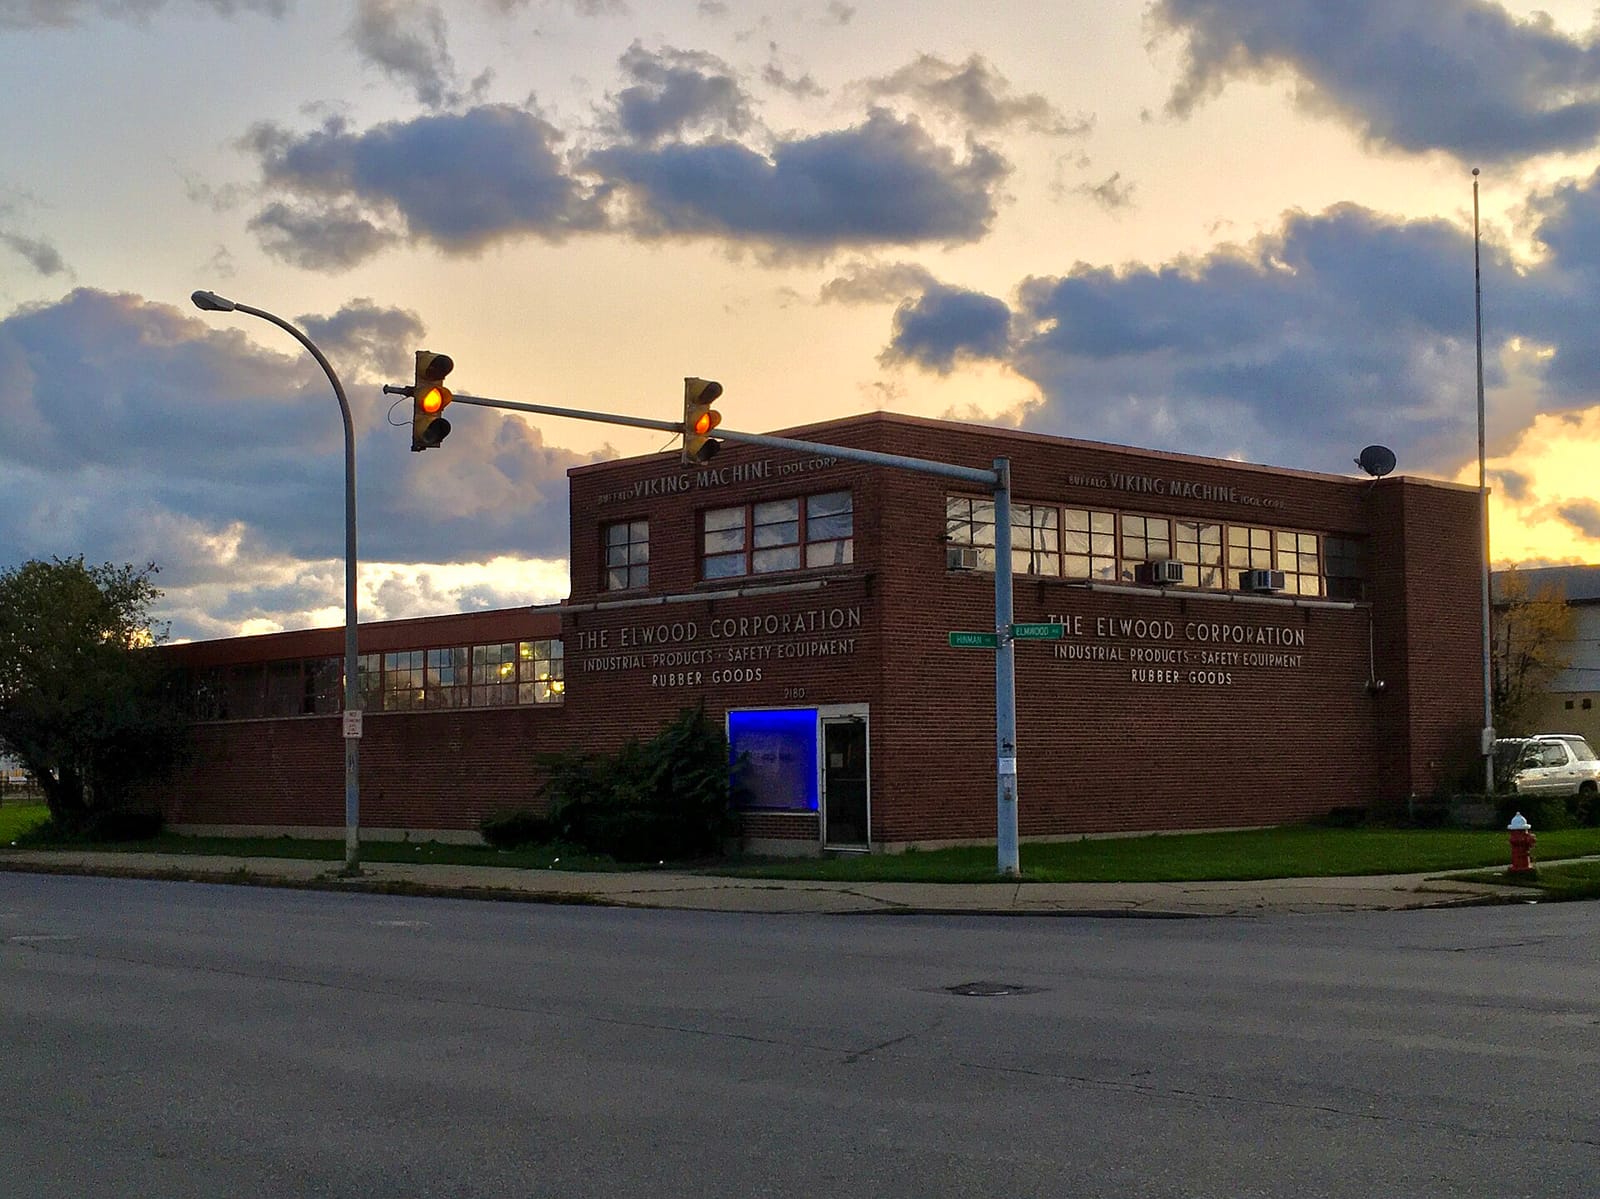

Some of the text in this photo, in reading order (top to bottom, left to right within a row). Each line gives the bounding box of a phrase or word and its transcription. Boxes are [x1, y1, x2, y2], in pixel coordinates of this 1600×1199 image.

[634, 474, 690, 498] VIKING
[696, 460, 772, 488] MACHINE
[777, 461, 803, 476] TOOL
[1110, 473, 1164, 495] VIKING
[1170, 481, 1237, 503] MACHINE
[578, 607, 862, 650] THE ELWOOD CORPORATION
[1016, 626, 1048, 636] ELMWOOD
[1097, 617, 1174, 640] ELWOOD
[1185, 622, 1305, 646] CORPORATION
[584, 639, 857, 672] INDUSTRIAL PRODUCTS SAFETY EQUIPMENT
[1055, 645, 1302, 667] INDUSTRIAL PRODUCTS SAFETY EQUIPMENT
[652, 668, 762, 687] RUBBER GOODS
[1131, 669, 1232, 684] RUBBER GOODS
[784, 688, 806, 699] 2180
